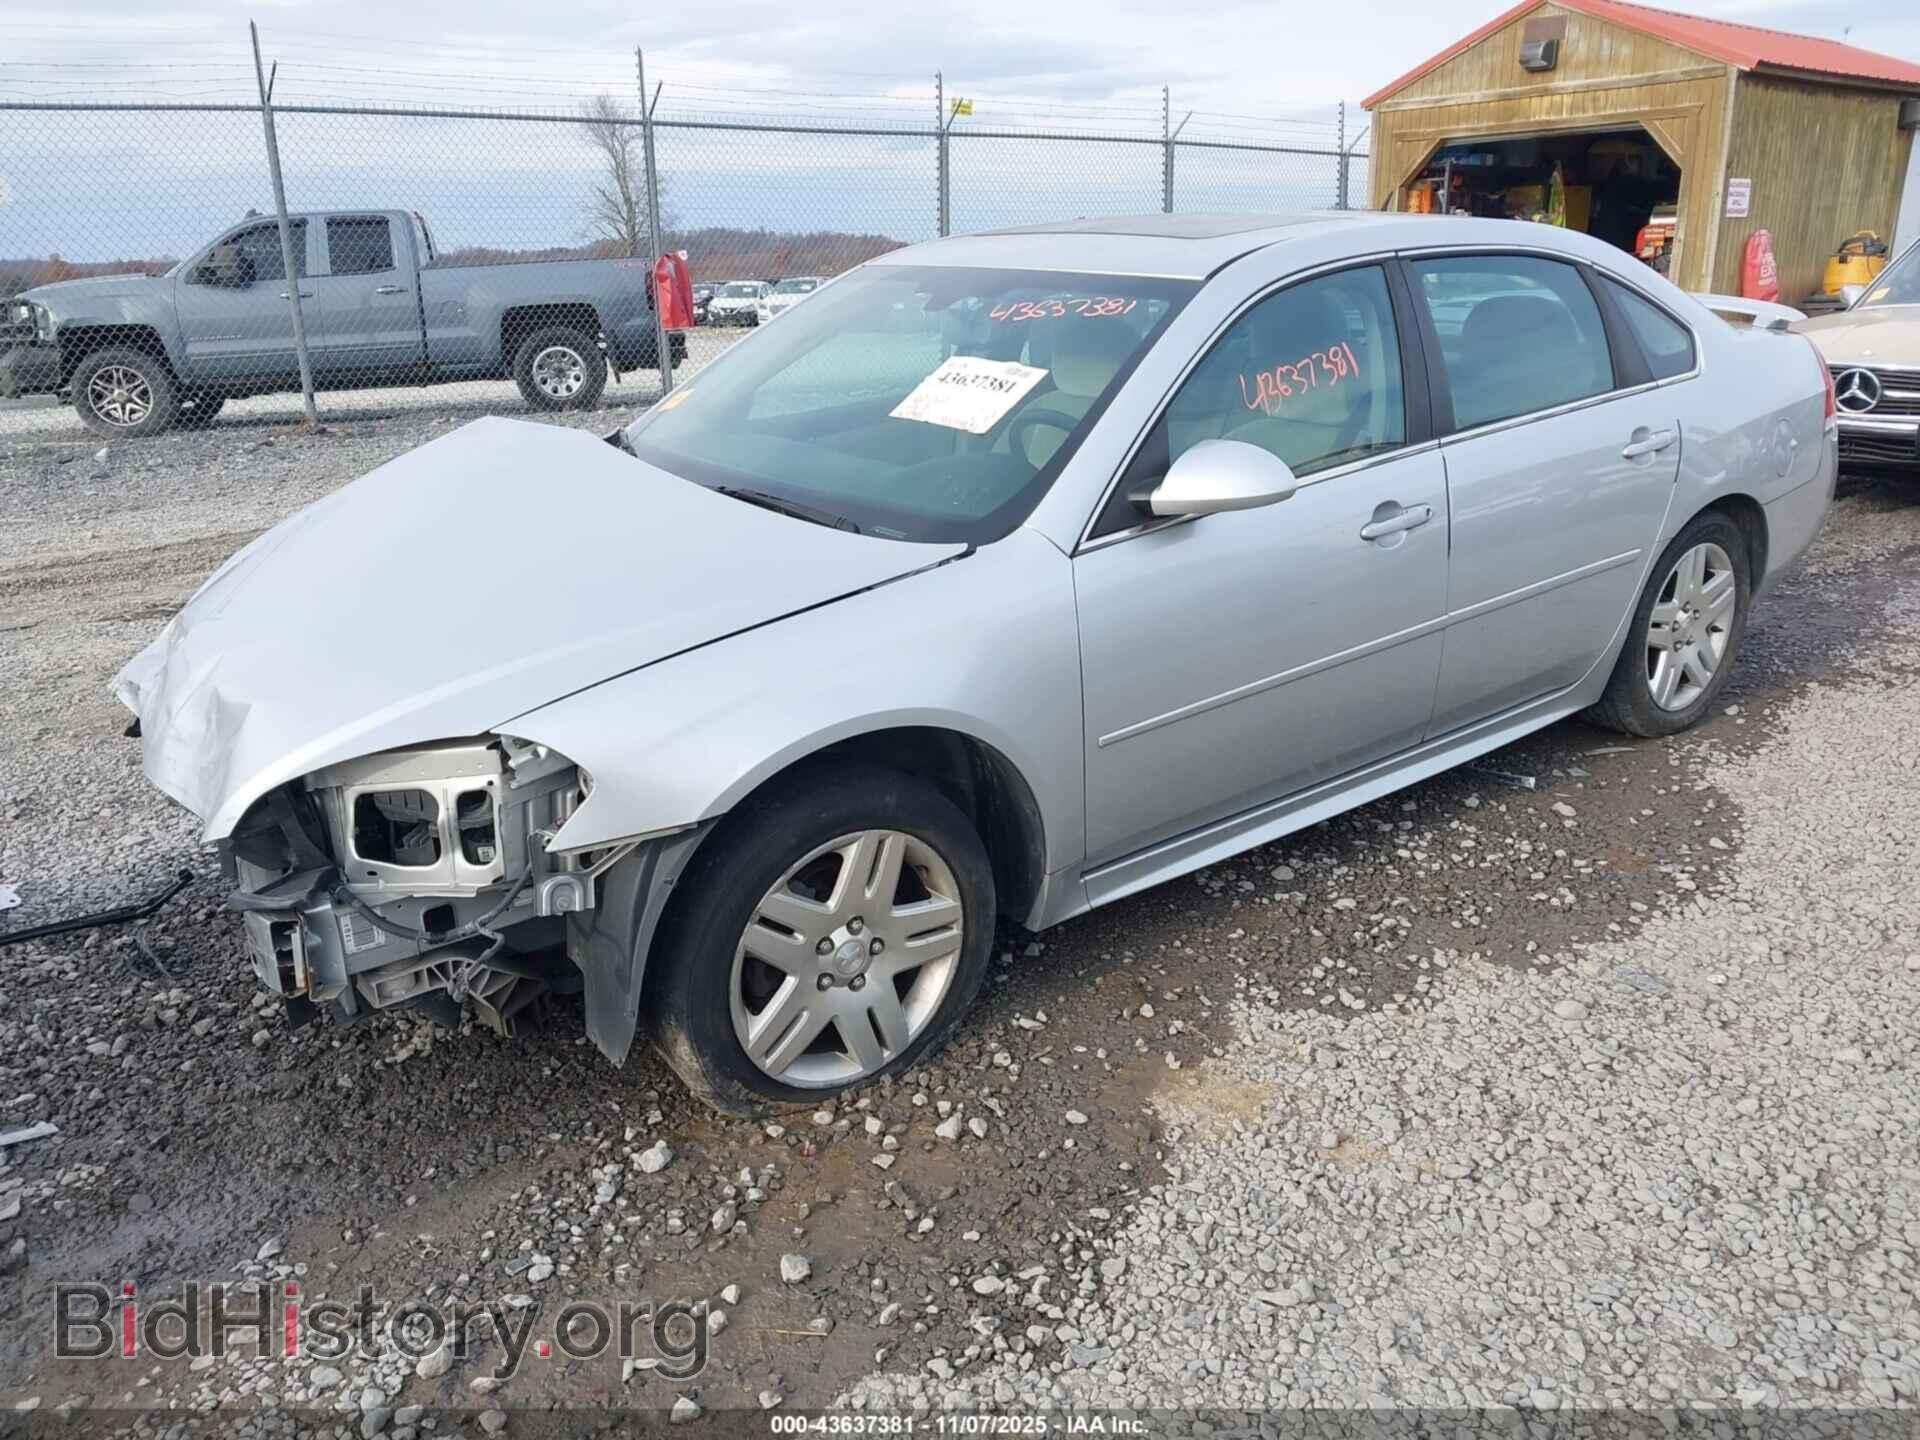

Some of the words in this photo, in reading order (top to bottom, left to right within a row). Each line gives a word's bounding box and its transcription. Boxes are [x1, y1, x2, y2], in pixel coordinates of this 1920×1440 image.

[989, 297, 1137, 321] 43637381
[937, 371, 1017, 394] 43637381
[1238, 341, 1359, 417] 43637381
